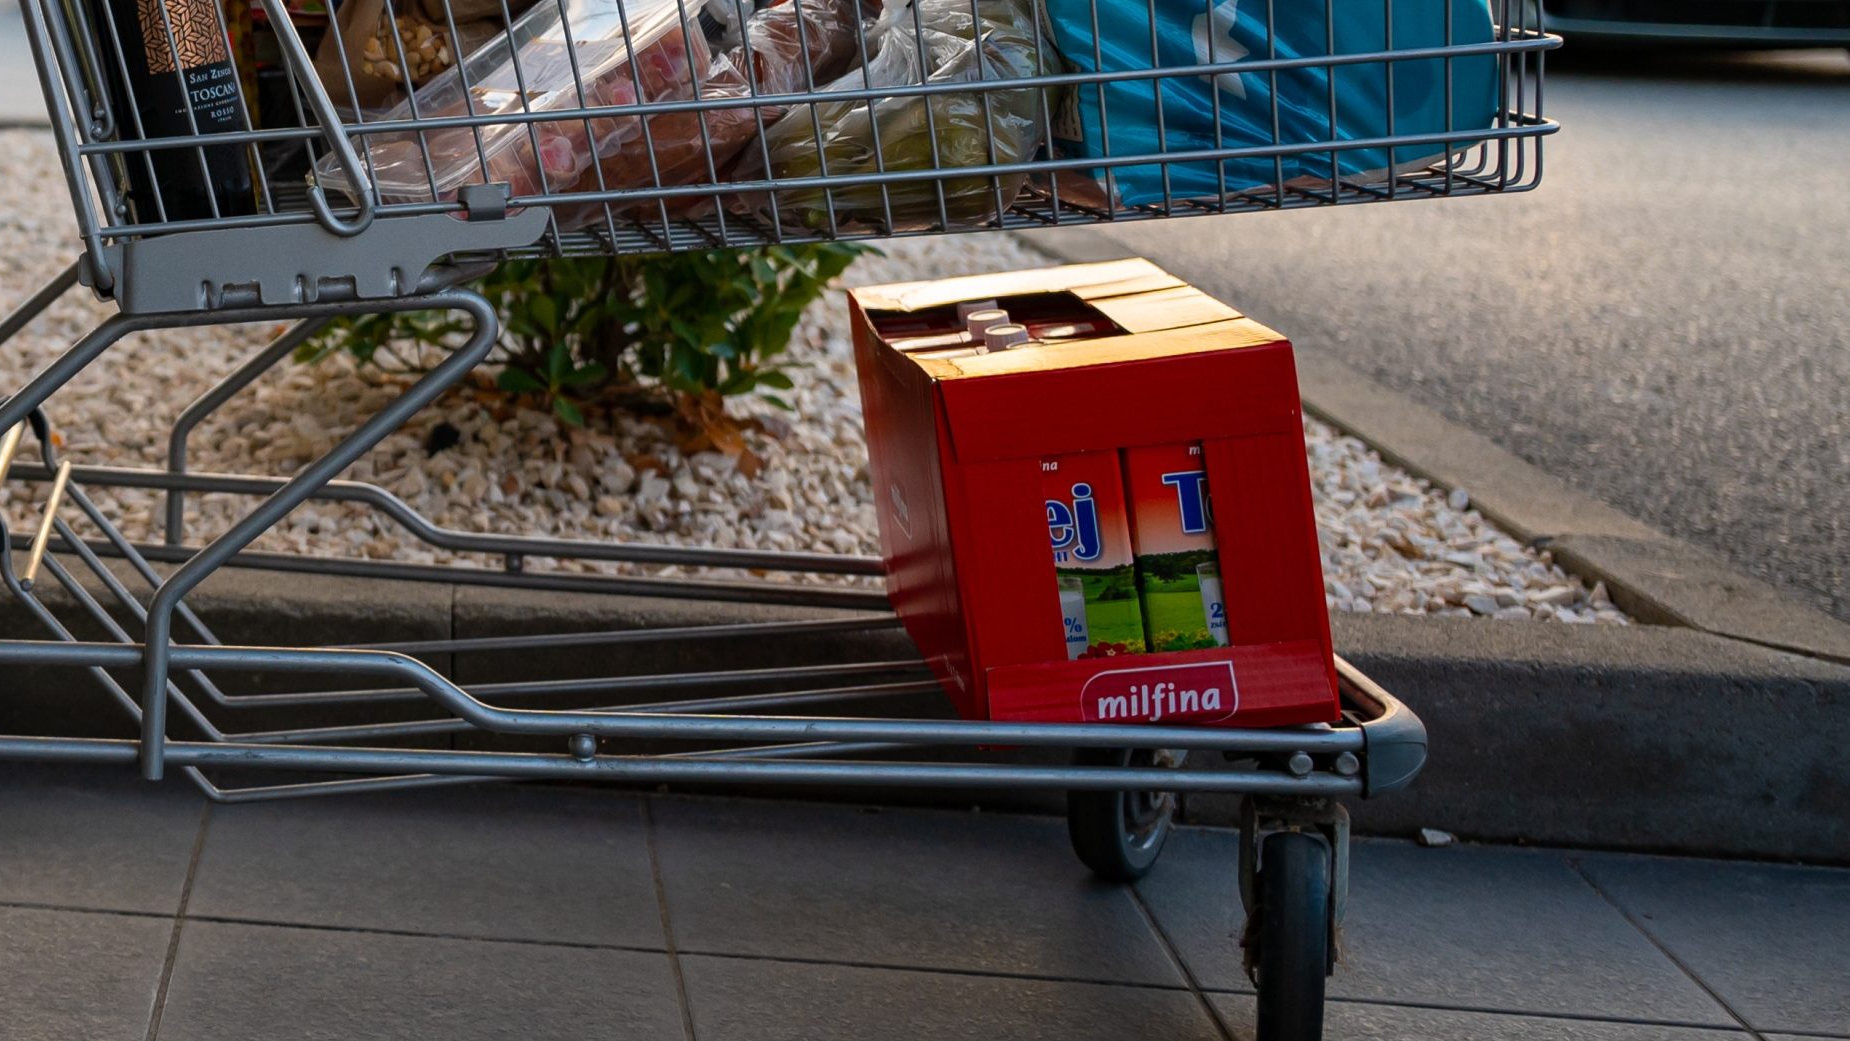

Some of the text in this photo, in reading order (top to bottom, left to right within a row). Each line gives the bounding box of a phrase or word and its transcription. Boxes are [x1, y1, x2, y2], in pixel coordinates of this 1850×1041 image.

[210, 105, 235, 119] ROSSO
[1161, 470, 1215, 534] T
[1097, 682, 1222, 722] milfina
